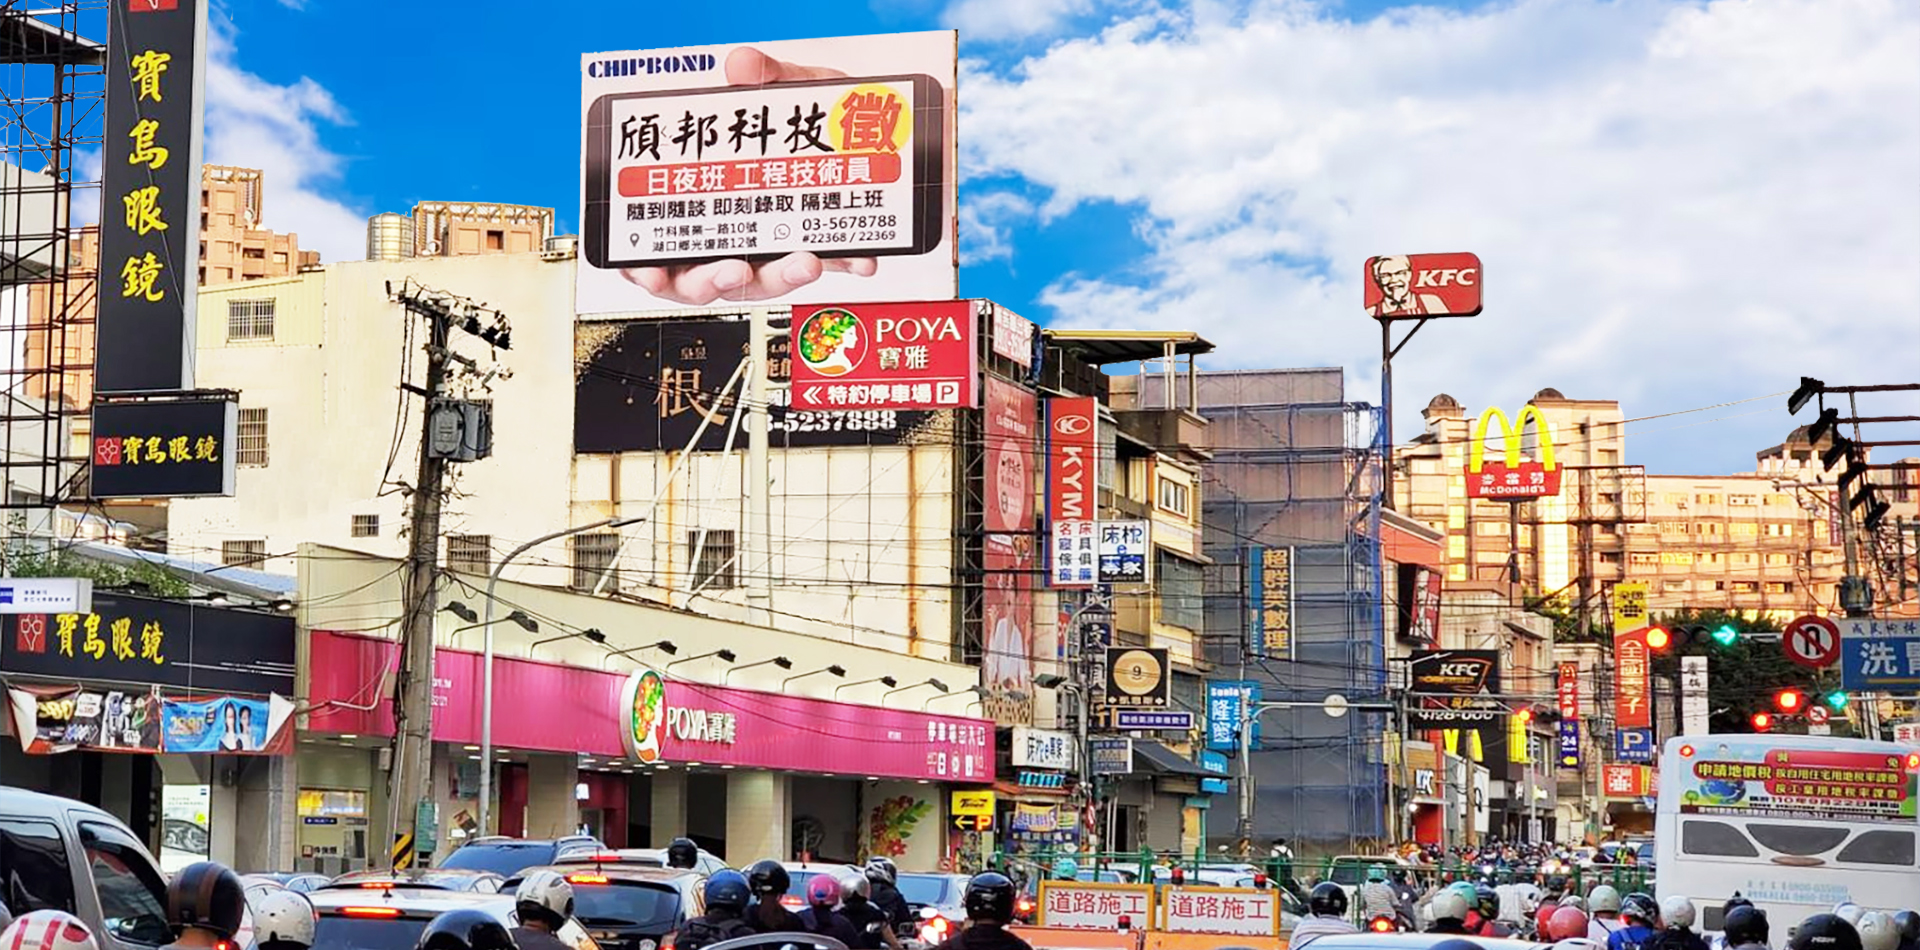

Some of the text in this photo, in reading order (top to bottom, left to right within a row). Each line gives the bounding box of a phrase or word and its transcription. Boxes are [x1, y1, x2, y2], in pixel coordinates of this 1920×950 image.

[588, 54, 716, 78] CHIPBOND
[617, 91, 902, 160] 頎邦科技 徵
[121, 49, 172, 302] 寶島眼鏡
[647, 157, 872, 195] 日夜班 工程技術員
[627, 189, 884, 221] 隨到隨談 即刻錄取 隔週上班
[802, 214, 897, 231] 03-5678788
[802, 232, 847, 245] #22368
[858, 229, 896, 242] 22369
[1415, 268, 1477, 287] KFC
[875, 317, 962, 343] POYA
[877, 345, 930, 371] 寶雅
[828, 382, 931, 405] 特約停車場
[122, 434, 218, 467] 寶島眼鏡
[1062, 446, 1083, 522] KYM
[1479, 484, 1545, 495] McDonald's
[55, 612, 164, 665] 寶島眼鏡
[1440, 663, 1480, 676] KFC
[667, 707, 736, 744] POYA 寶雅
[1562, 736, 1576, 747] 24
[1623, 732, 1645, 750] P
[1698, 763, 1771, 779] 申請地價稅
[977, 815, 991, 830] P
[1048, 892, 1146, 915] 道路施工
[1170, 894, 1269, 919] 道路施工
